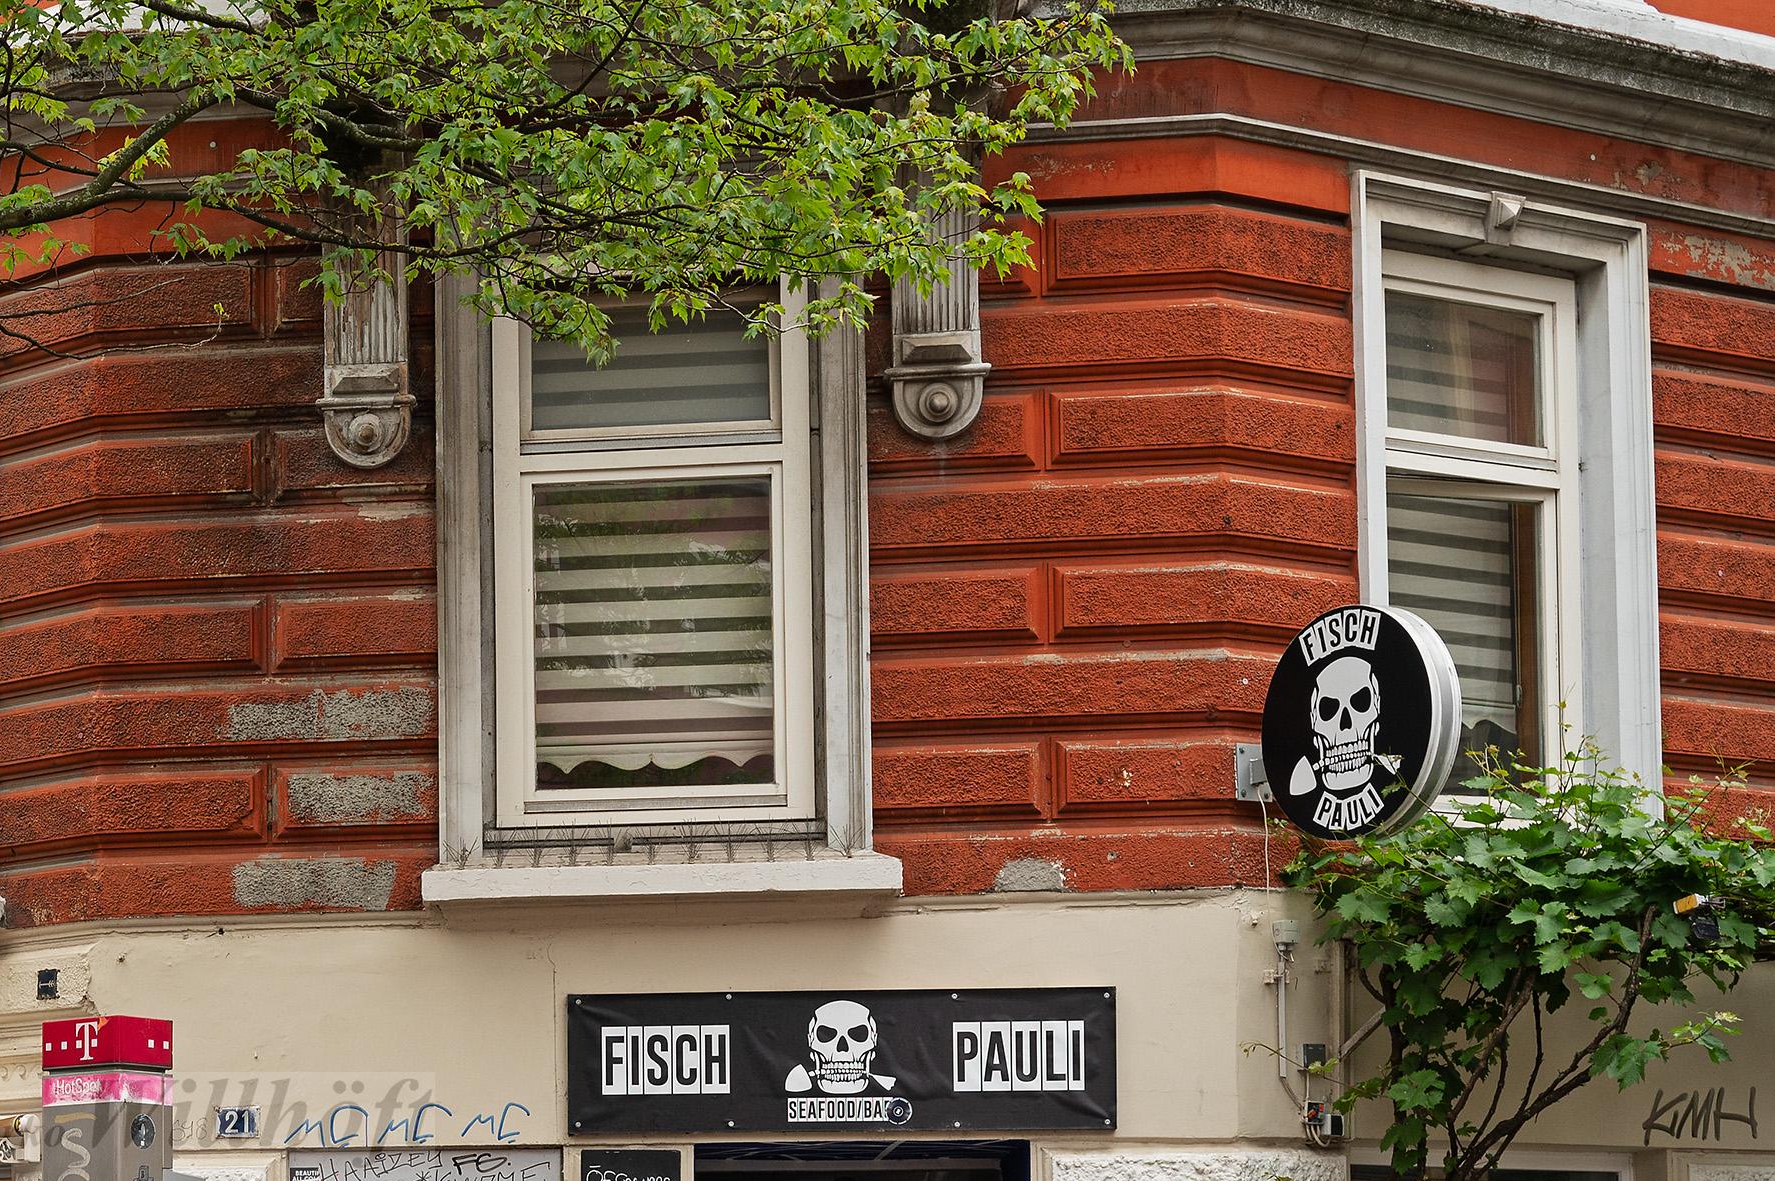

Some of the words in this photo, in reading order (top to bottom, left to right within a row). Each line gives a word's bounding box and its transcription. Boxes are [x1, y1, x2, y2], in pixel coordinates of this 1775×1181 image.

[1300, 610, 1381, 664] FISCH
[1316, 785, 1383, 830] PAULI
[604, 1033, 728, 1087] FISCH
[955, 1029, 1084, 1084] PAULI
[225, 1110, 251, 1134] 21
